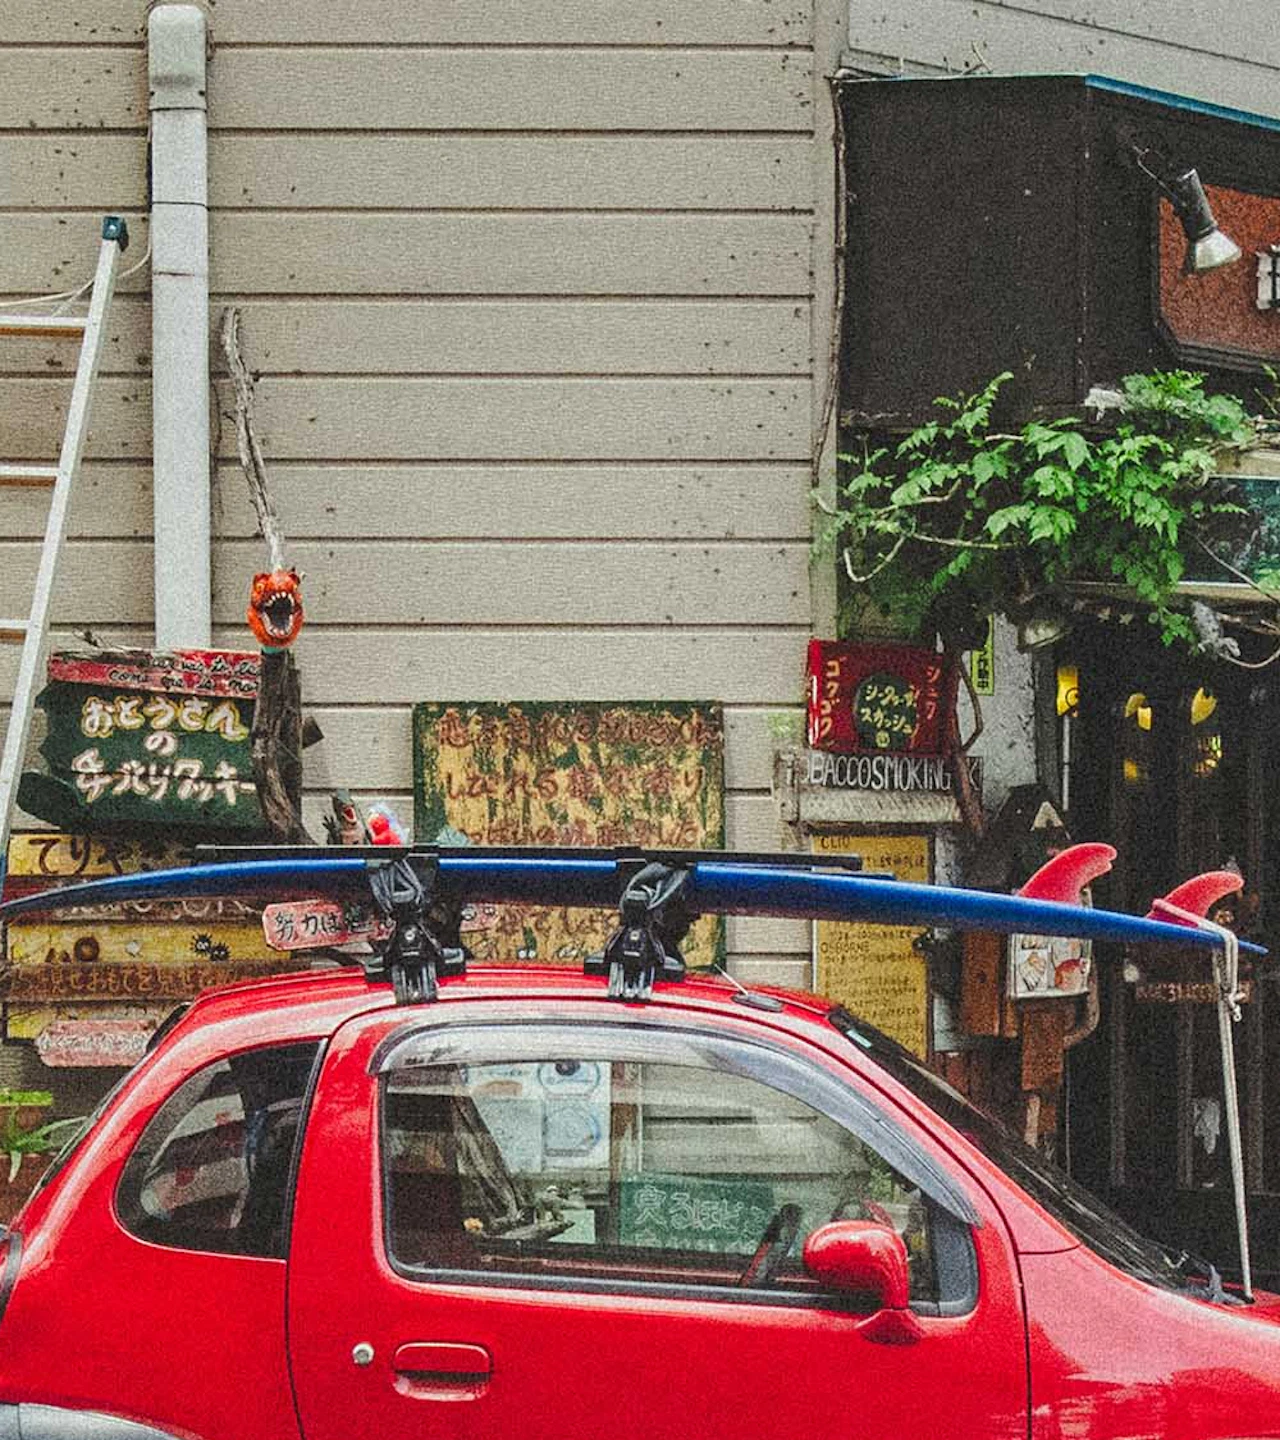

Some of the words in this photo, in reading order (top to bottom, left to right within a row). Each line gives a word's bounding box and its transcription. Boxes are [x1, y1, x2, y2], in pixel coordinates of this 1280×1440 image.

[81, 696, 249, 741] おとうさん
[145, 731, 178, 756] の
